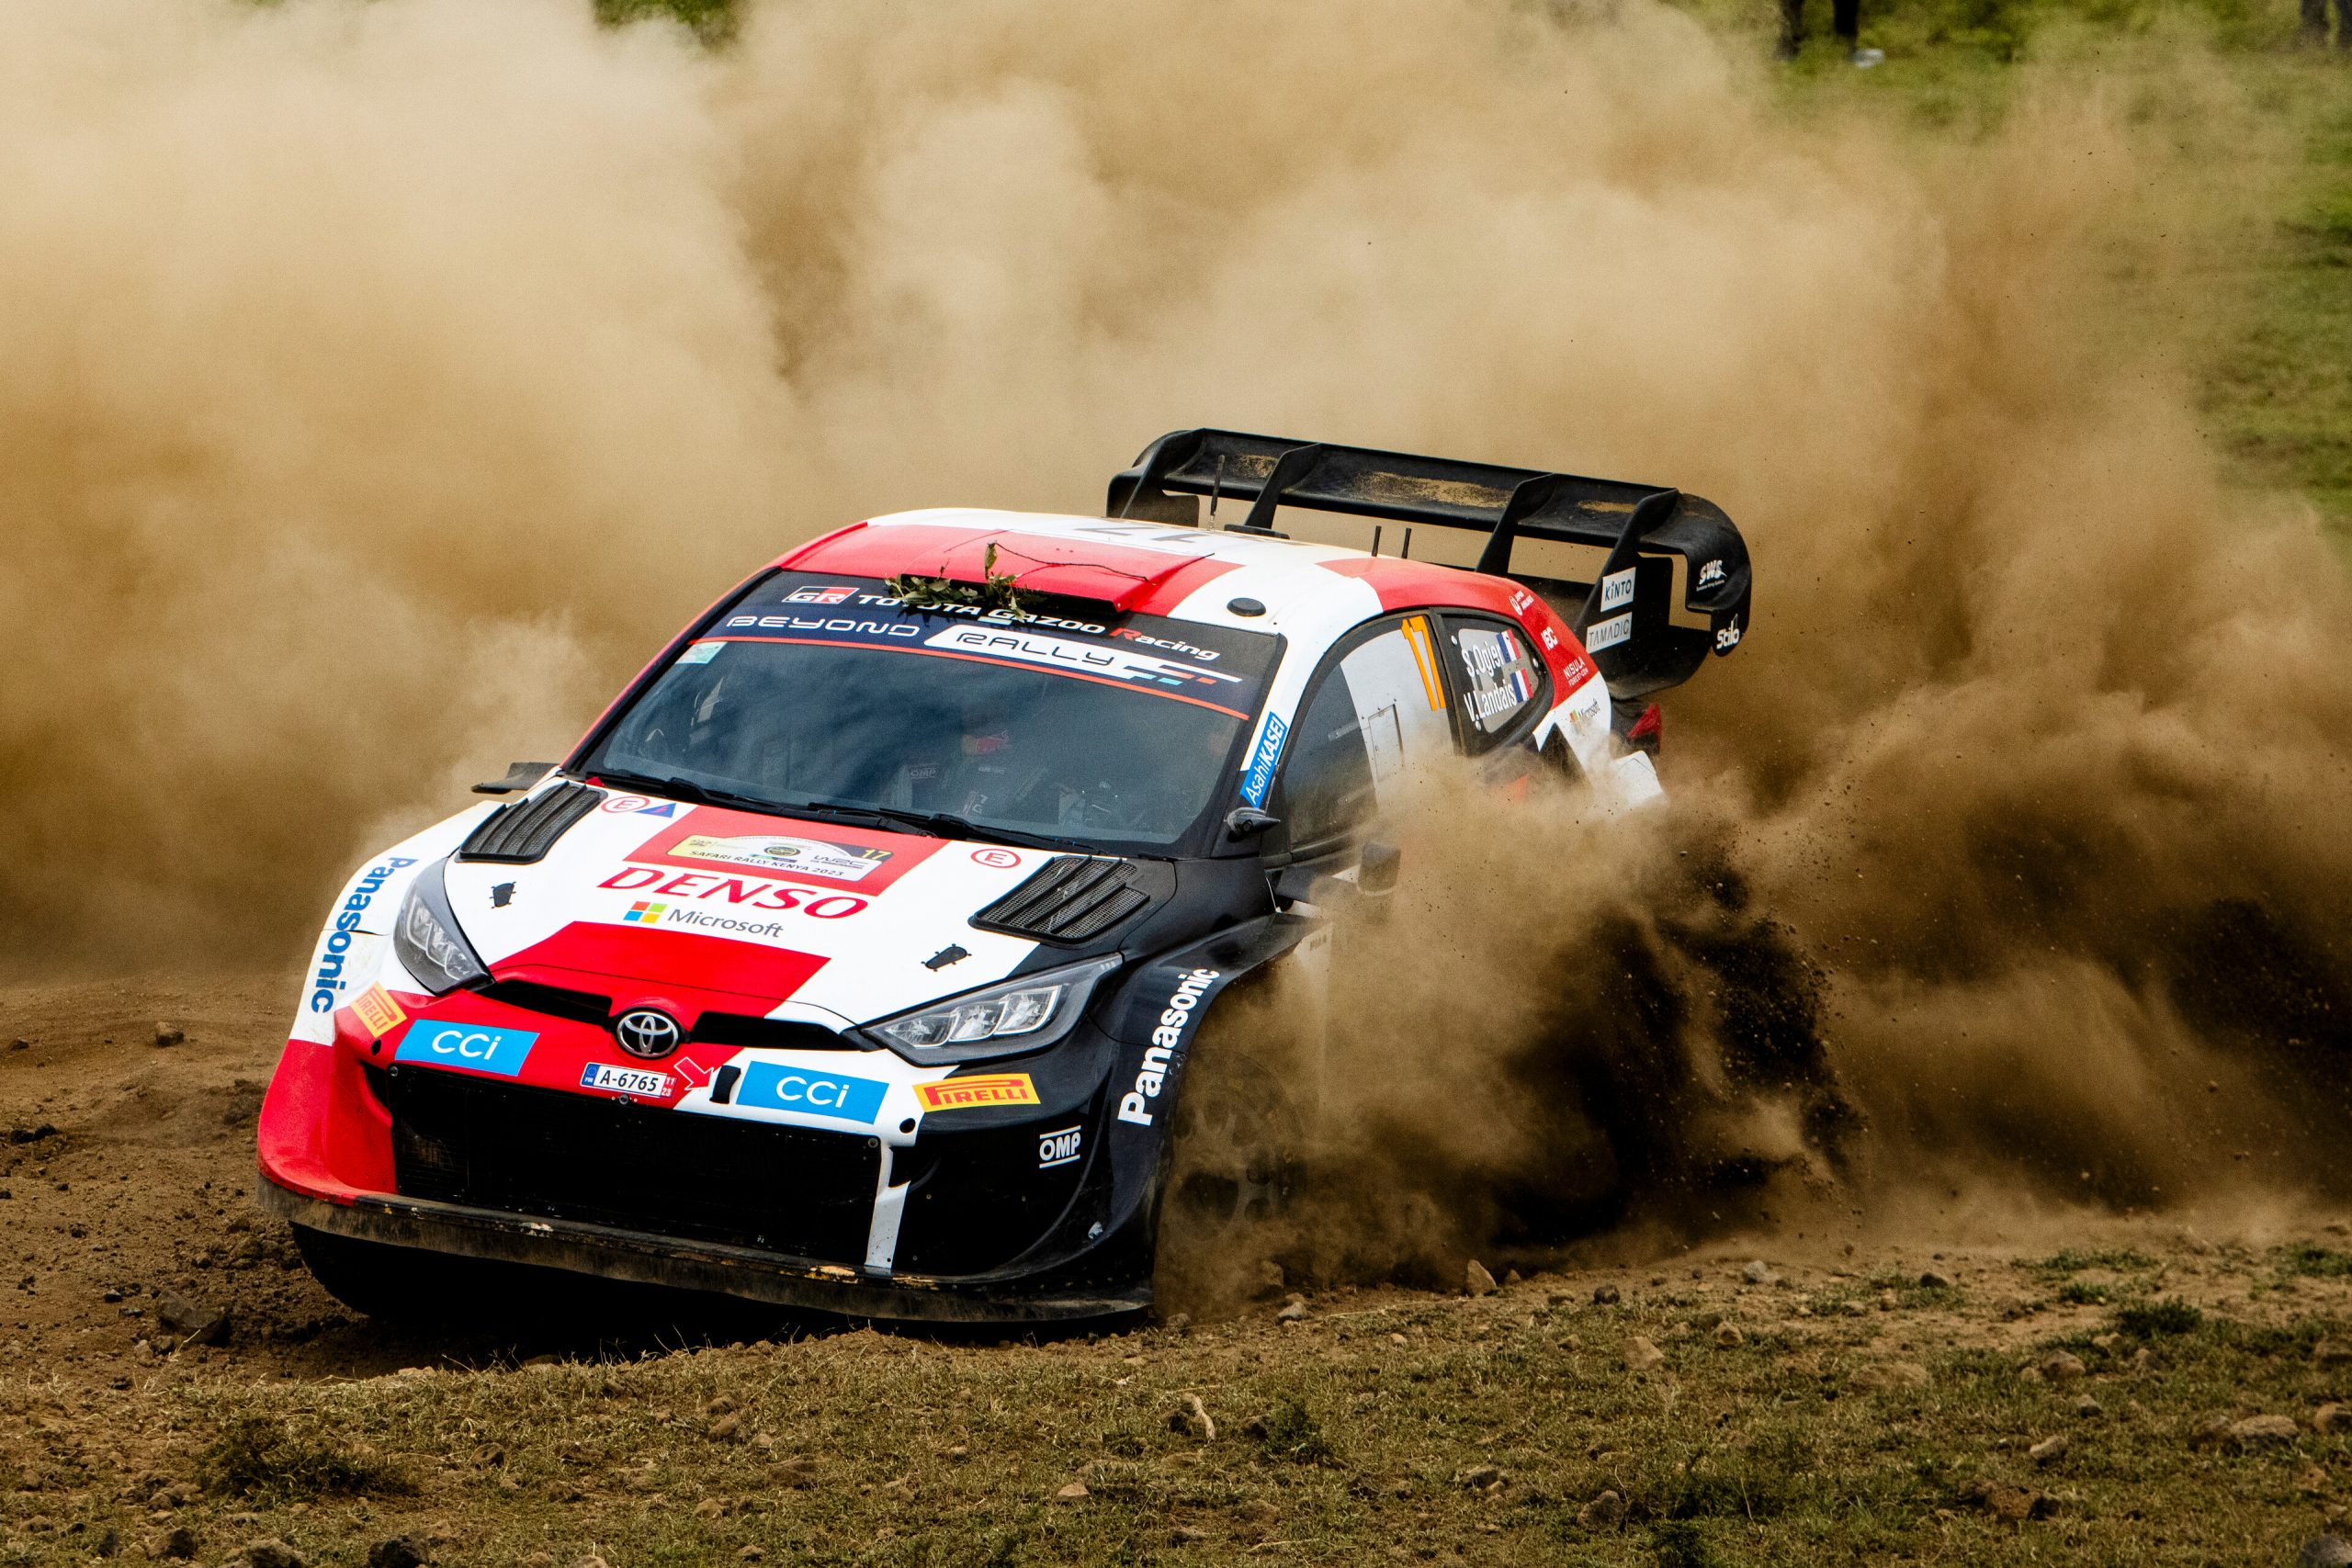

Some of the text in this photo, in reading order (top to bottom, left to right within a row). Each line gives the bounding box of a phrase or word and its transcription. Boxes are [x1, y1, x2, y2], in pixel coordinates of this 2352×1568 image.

[1699, 559, 1726, 584] SWS
[727, 615, 1114, 666] BEYOND RALLY
[788, 592, 843, 605] GR
[858, 594, 982, 615] TOTA
[1109, 627, 1221, 661] Racing
[1589, 618, 1631, 648] TAMADIC
[1716, 615, 1740, 649] Stilo
[1401, 615, 1447, 712] 17
[1562, 656, 1586, 680] NISULA
[1246, 716, 1284, 806] AsahiKASEI
[691, 851, 732, 860] SAFARI
[734, 855, 768, 864] RALLY
[772, 862, 809, 871] KENYA
[812, 867, 844, 876] 2023
[862, 849, 892, 861] 17
[596, 867, 869, 919] DENSO
[311, 857, 416, 1014] Panasonic
[667, 908, 785, 938] Microsoft
[1117, 968, 1220, 1126] Panasonic
[599, 1069, 659, 1092] A-6765
[924, 1078, 1030, 1106] PIRELLI
[1039, 1132, 1081, 1162] OMP
